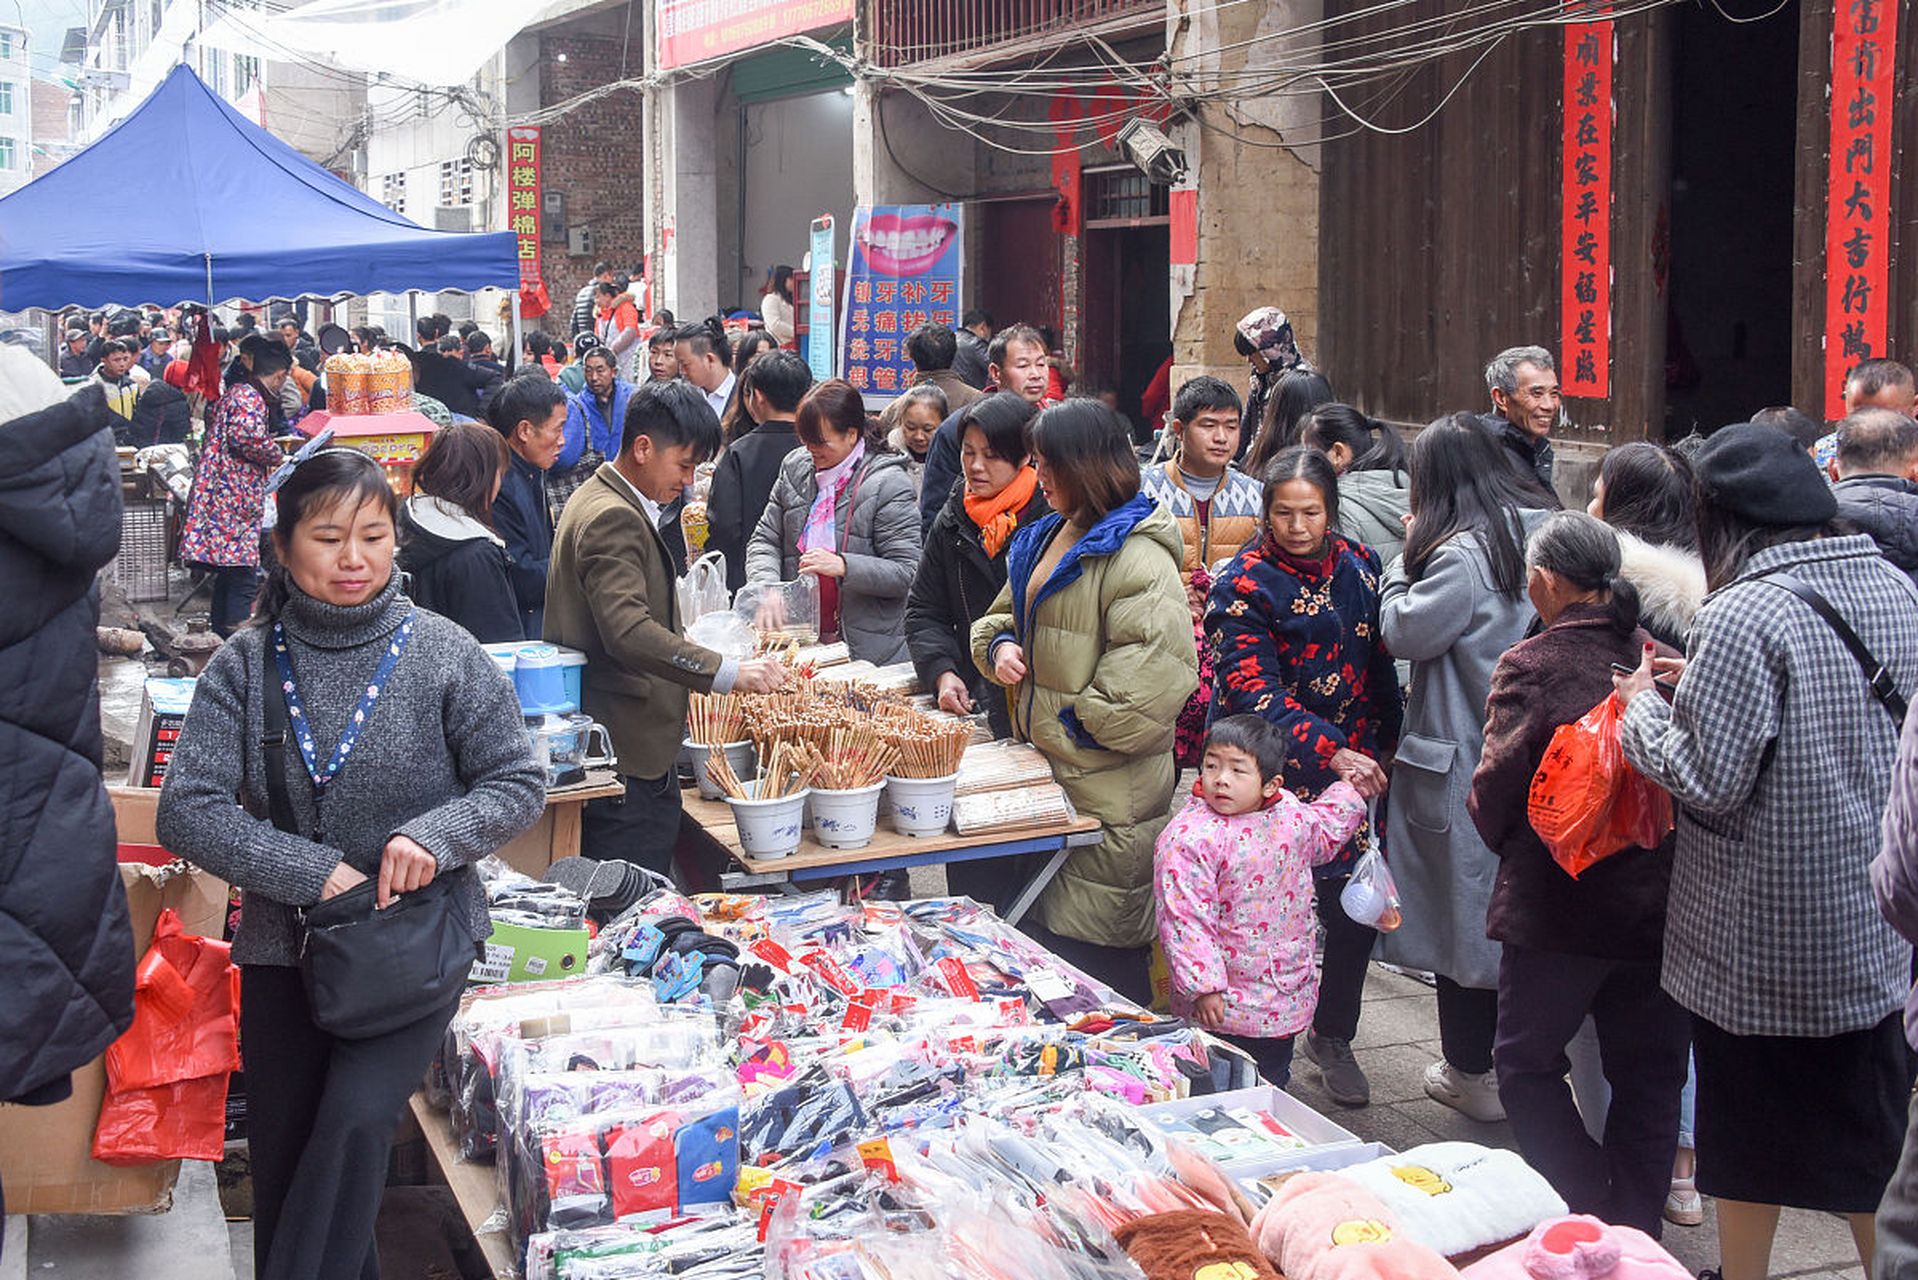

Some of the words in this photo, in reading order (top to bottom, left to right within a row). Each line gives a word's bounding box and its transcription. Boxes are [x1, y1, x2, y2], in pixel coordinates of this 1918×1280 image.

[512, 142, 537, 259] 阿楼弹棉店
[849, 338, 912, 361] 洗牙
